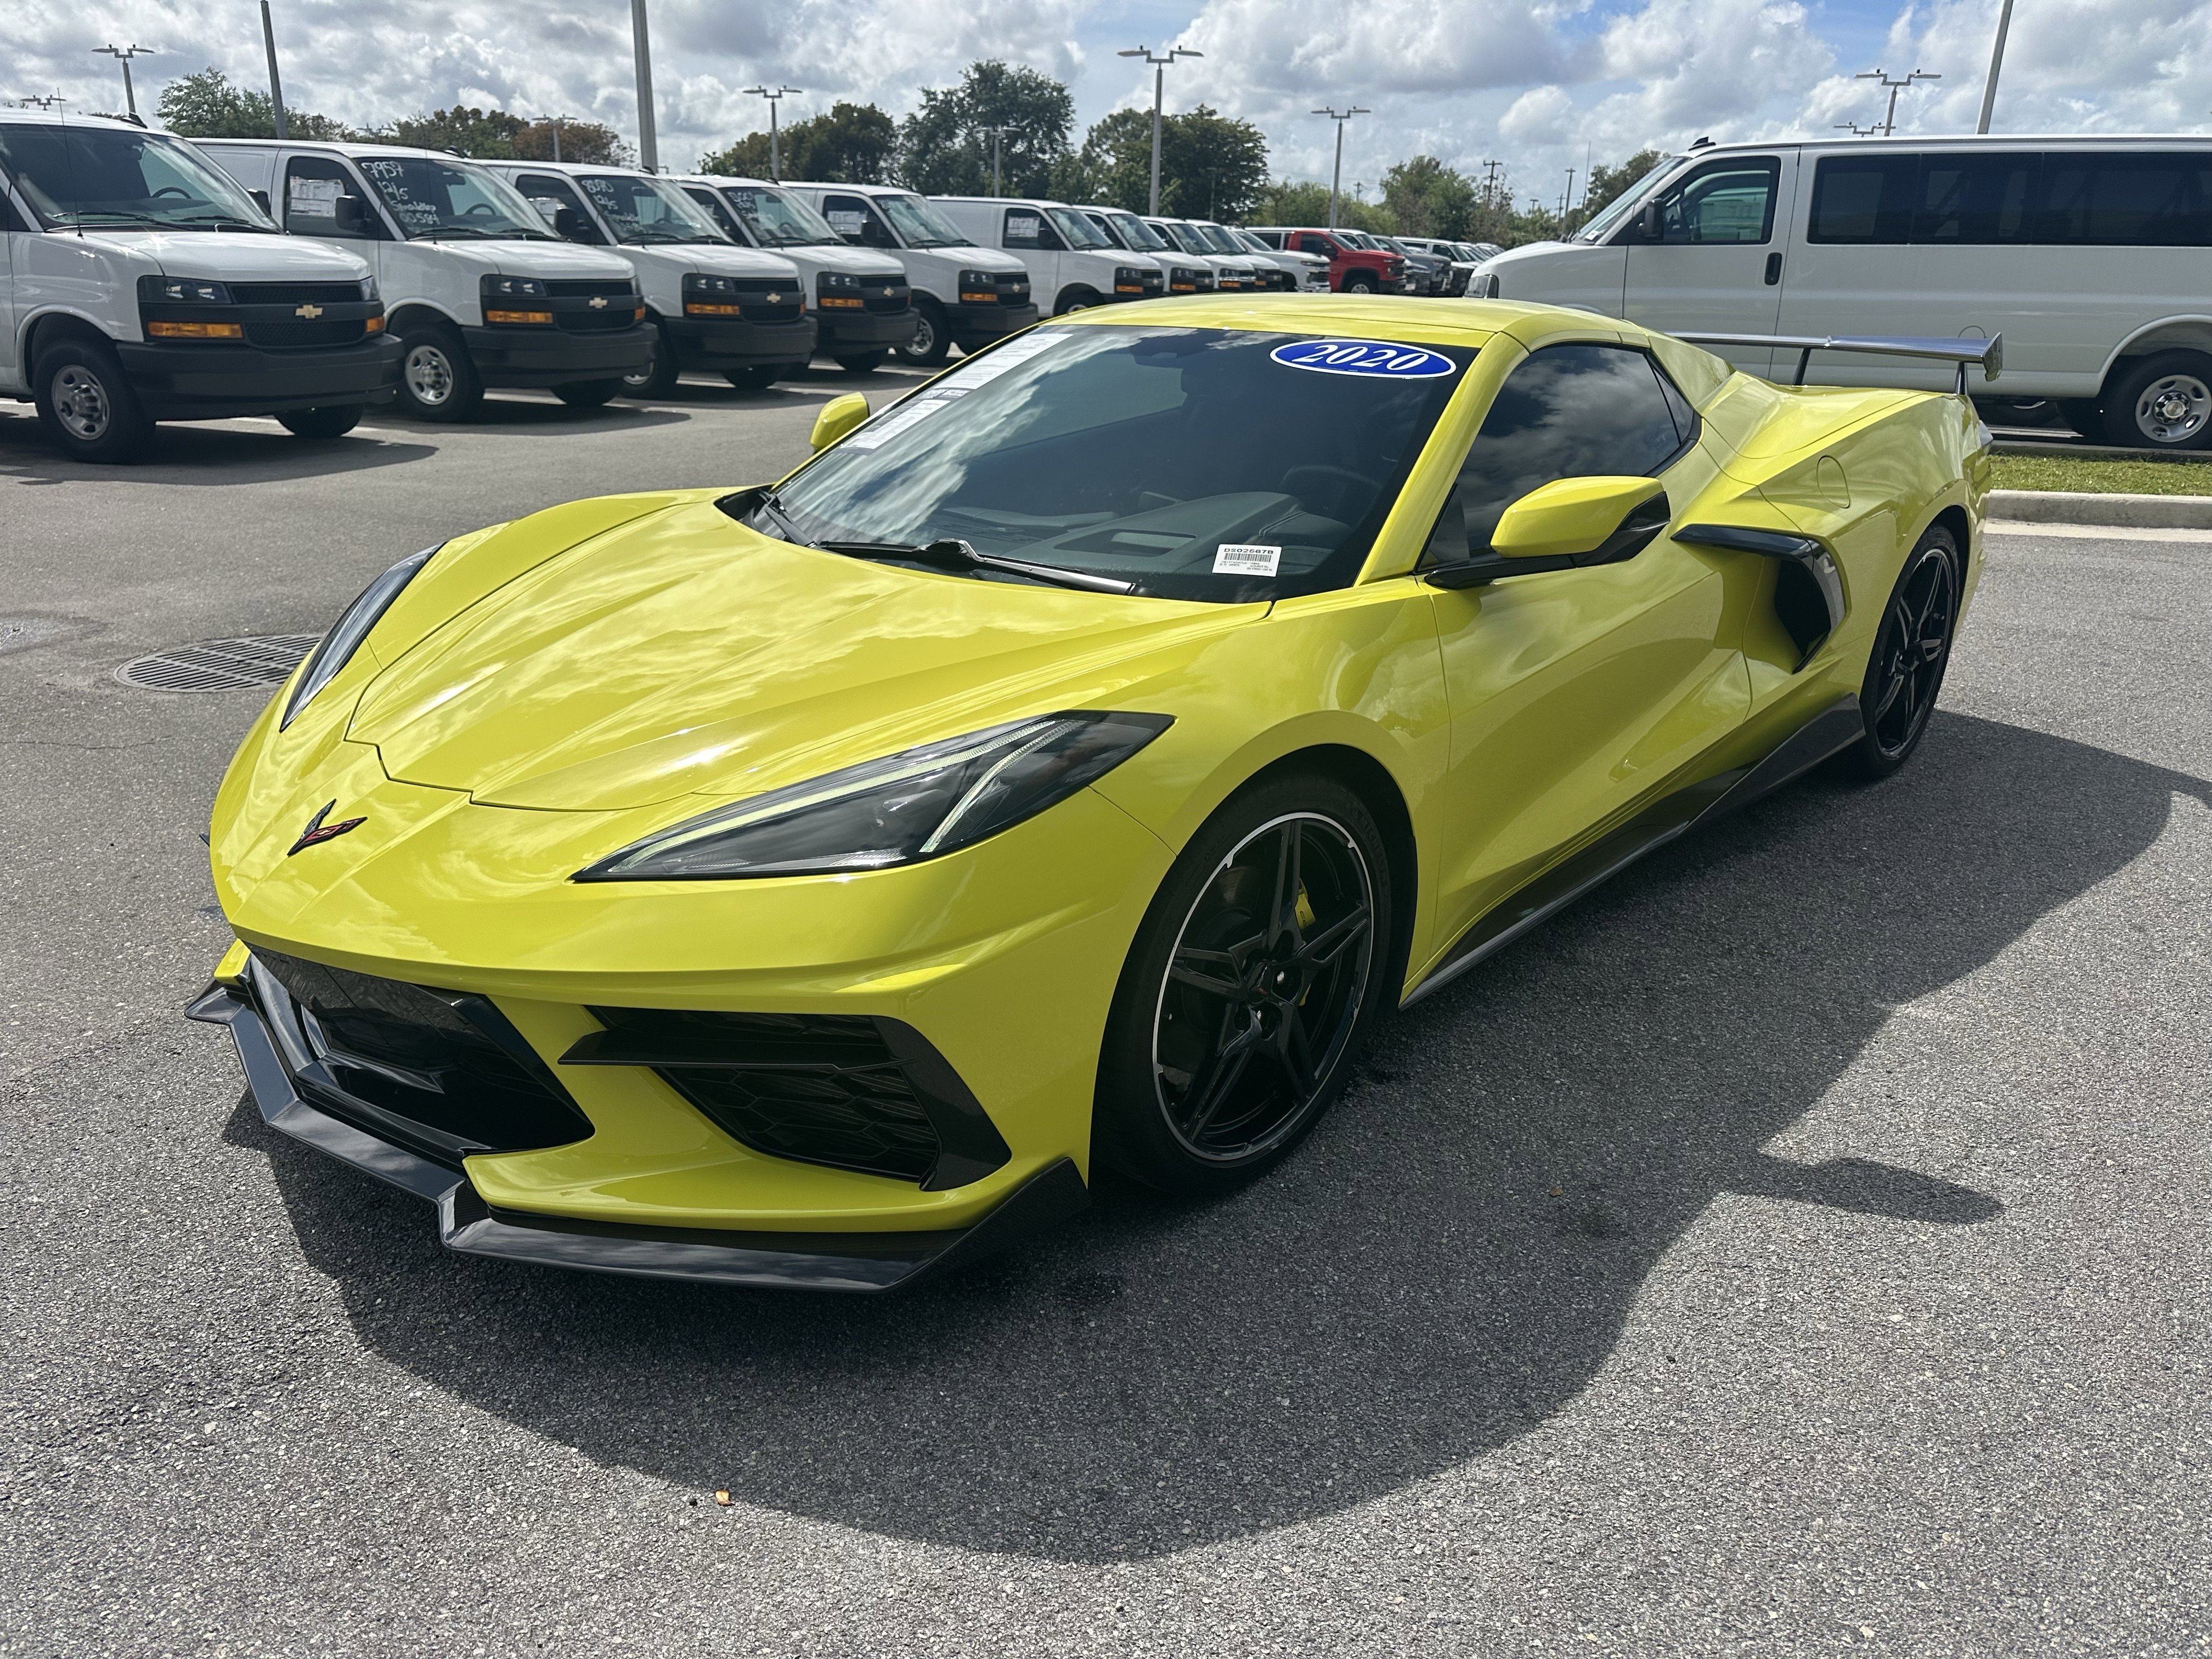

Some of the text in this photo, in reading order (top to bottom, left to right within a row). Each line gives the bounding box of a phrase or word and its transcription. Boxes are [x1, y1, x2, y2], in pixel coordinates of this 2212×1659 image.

[361, 161, 404, 179] 7957
[377, 181, 409, 200] 12/5
[1291, 345, 1429, 371] 2020
